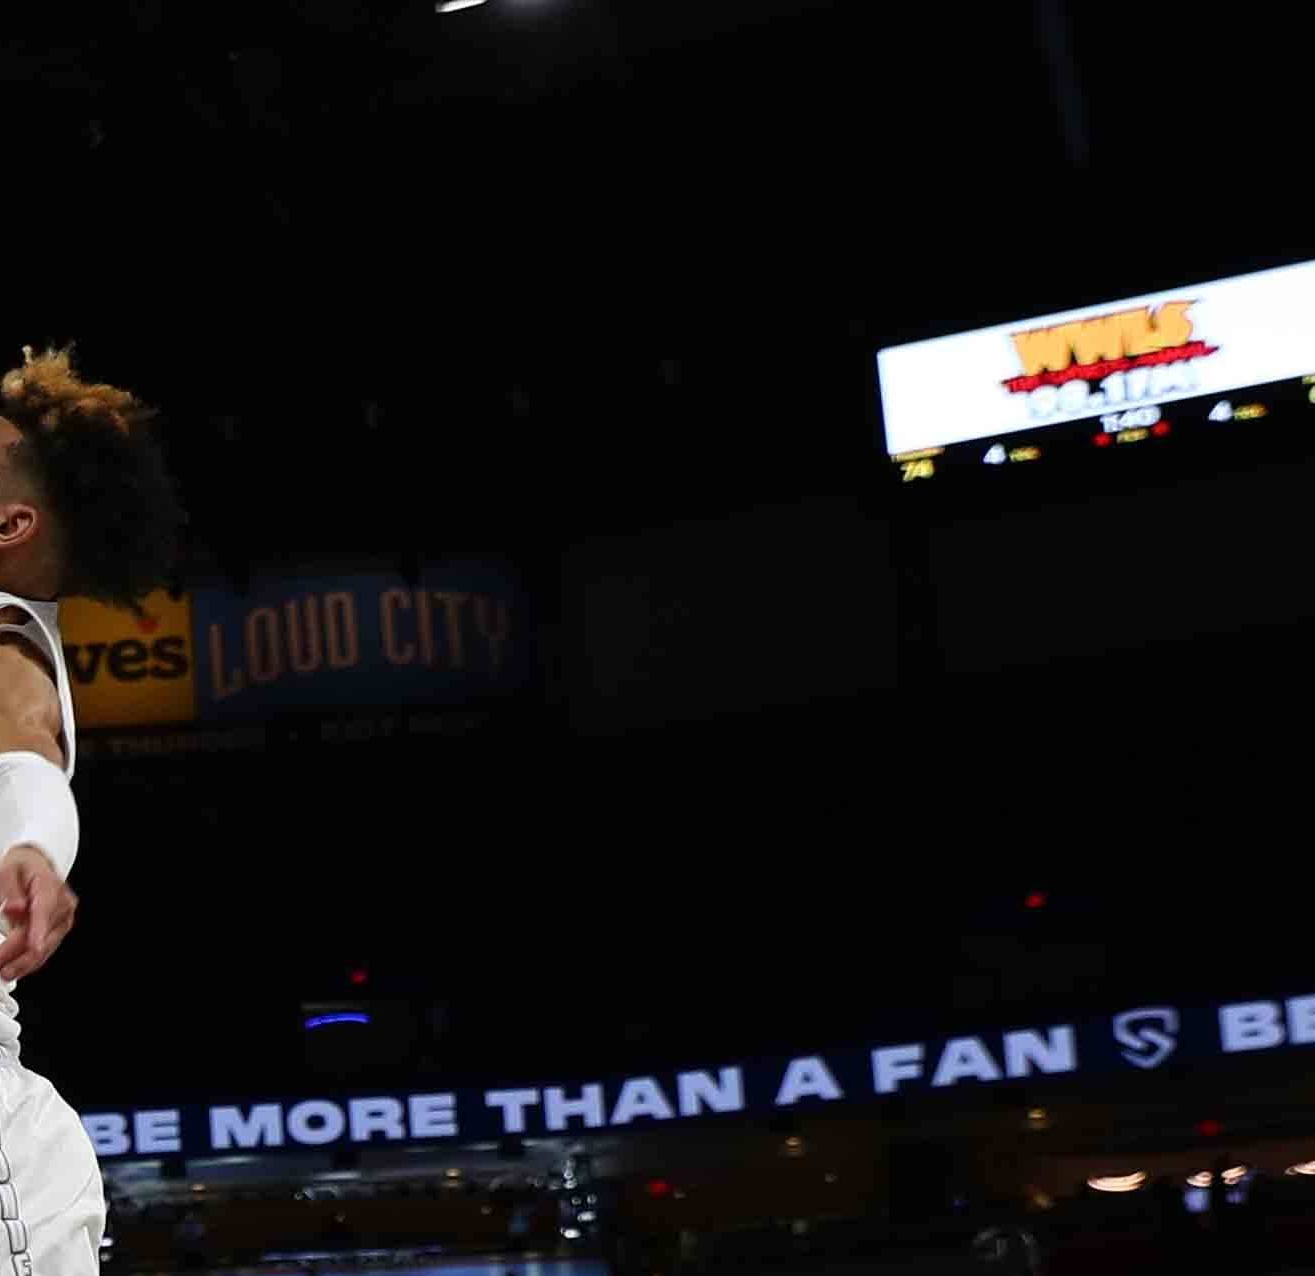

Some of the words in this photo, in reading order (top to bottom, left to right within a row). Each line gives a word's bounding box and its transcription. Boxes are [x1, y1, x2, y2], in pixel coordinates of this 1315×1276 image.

[63, 635, 189, 682] ves
[83, 1109, 182, 1157] BE
[209, 1093, 459, 1150] MORE
[485, 1067, 745, 1133] THAN
[775, 1057, 842, 1105] A
[871, 1026, 1077, 1094] FAN
